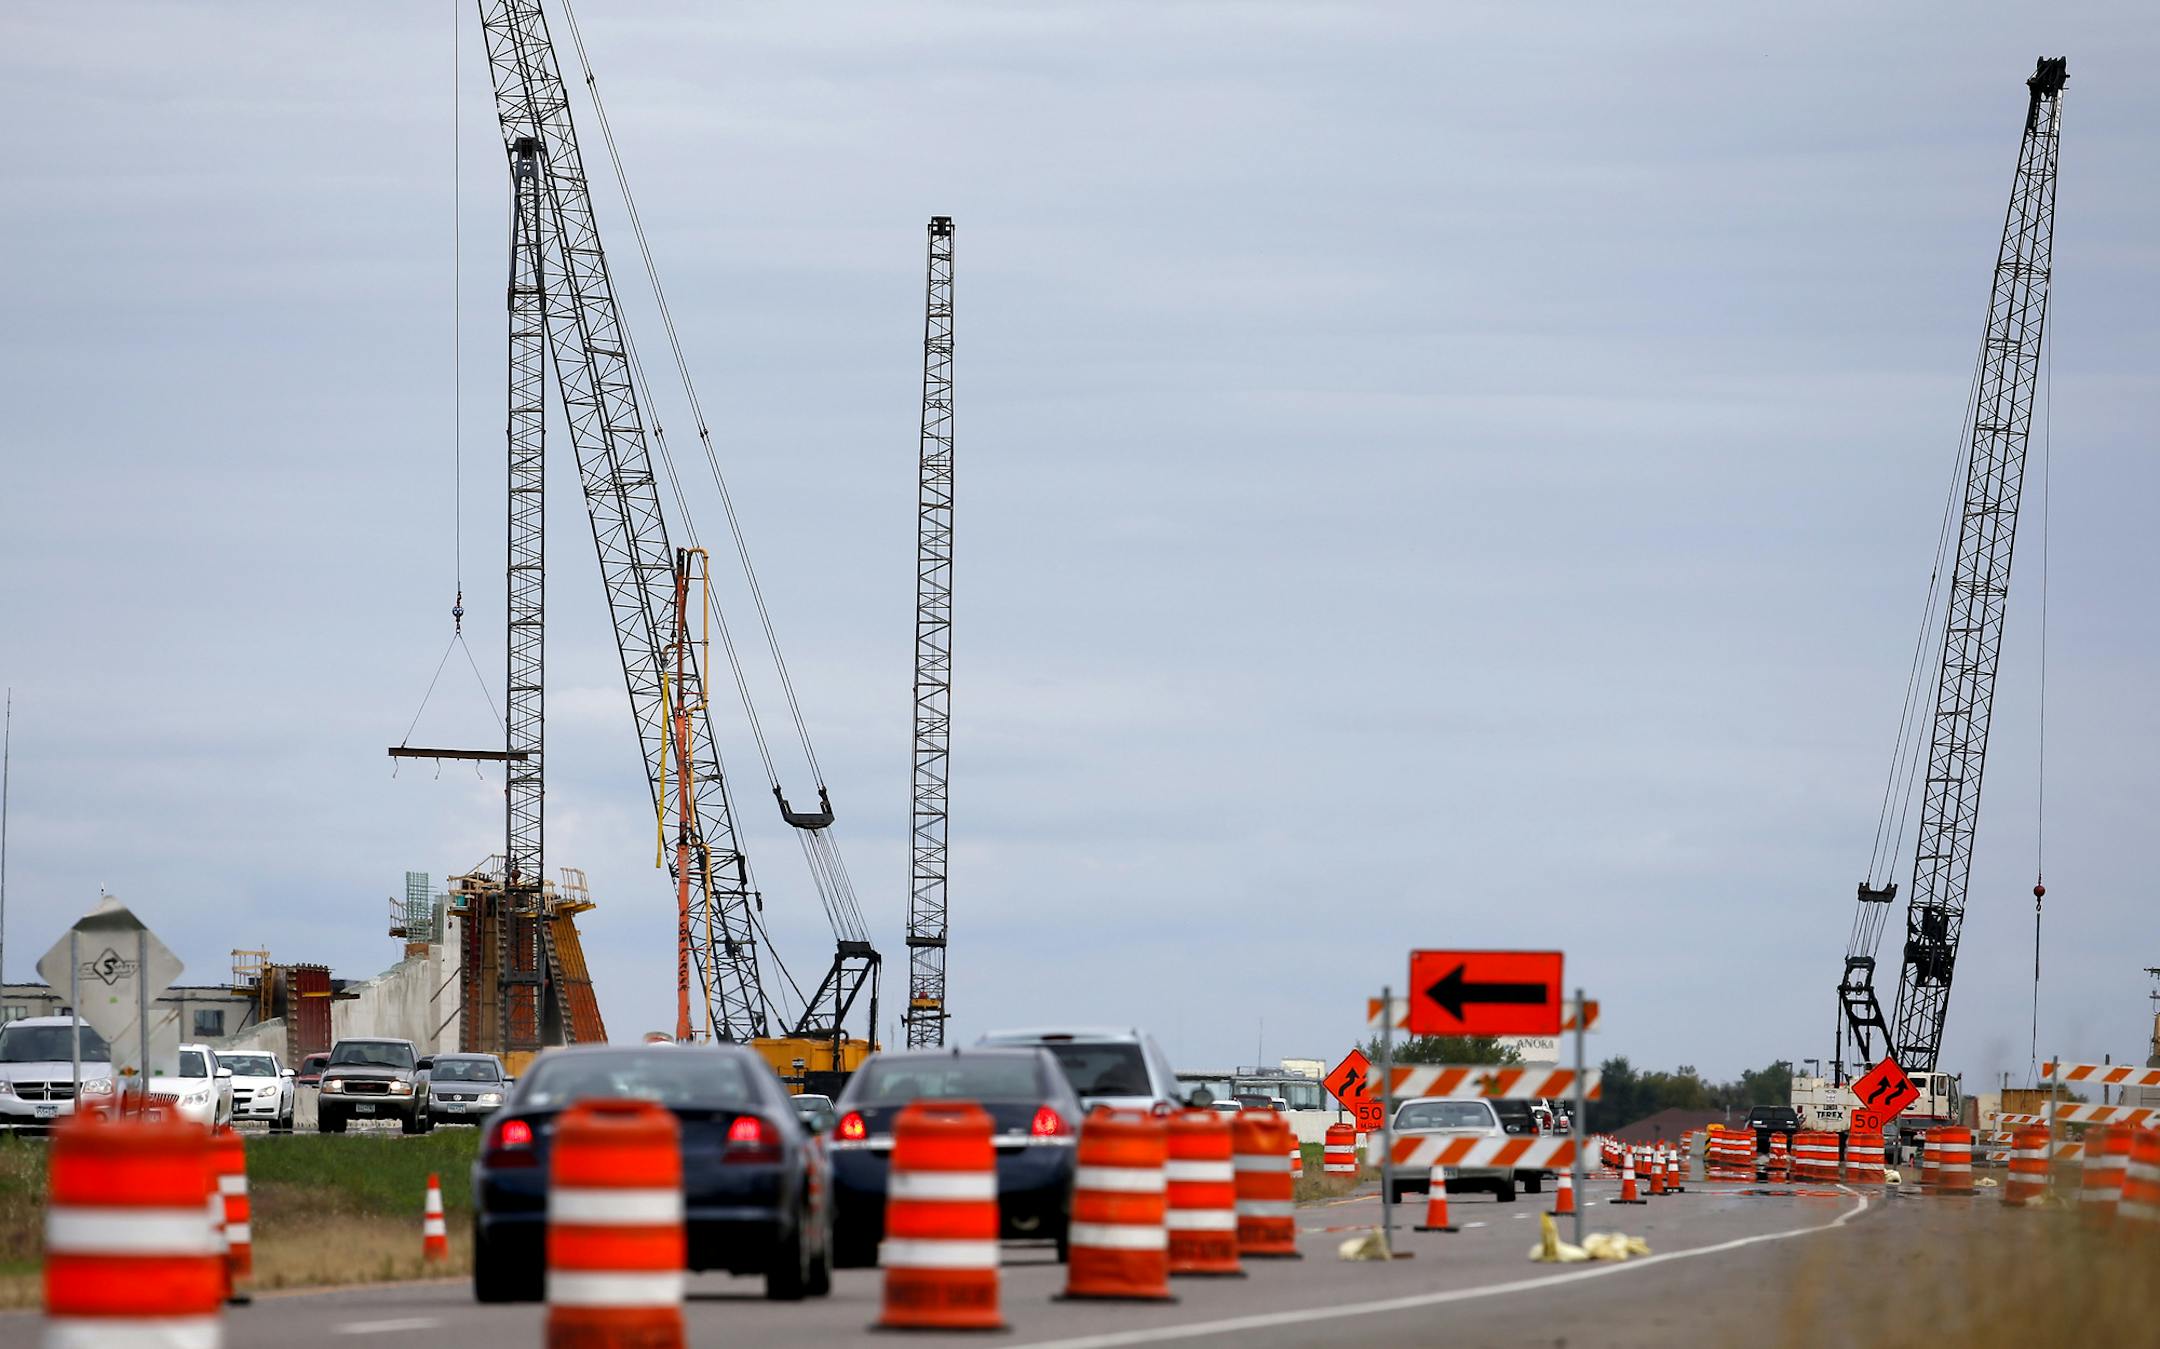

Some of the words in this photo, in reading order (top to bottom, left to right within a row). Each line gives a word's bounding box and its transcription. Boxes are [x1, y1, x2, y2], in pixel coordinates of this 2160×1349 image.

[1516, 1039, 1554, 1050] ANOKA
[1360, 1106, 1382, 1120] 50
[1816, 1111, 1843, 1119] TEREX
[1855, 1114, 1879, 1129] 50
